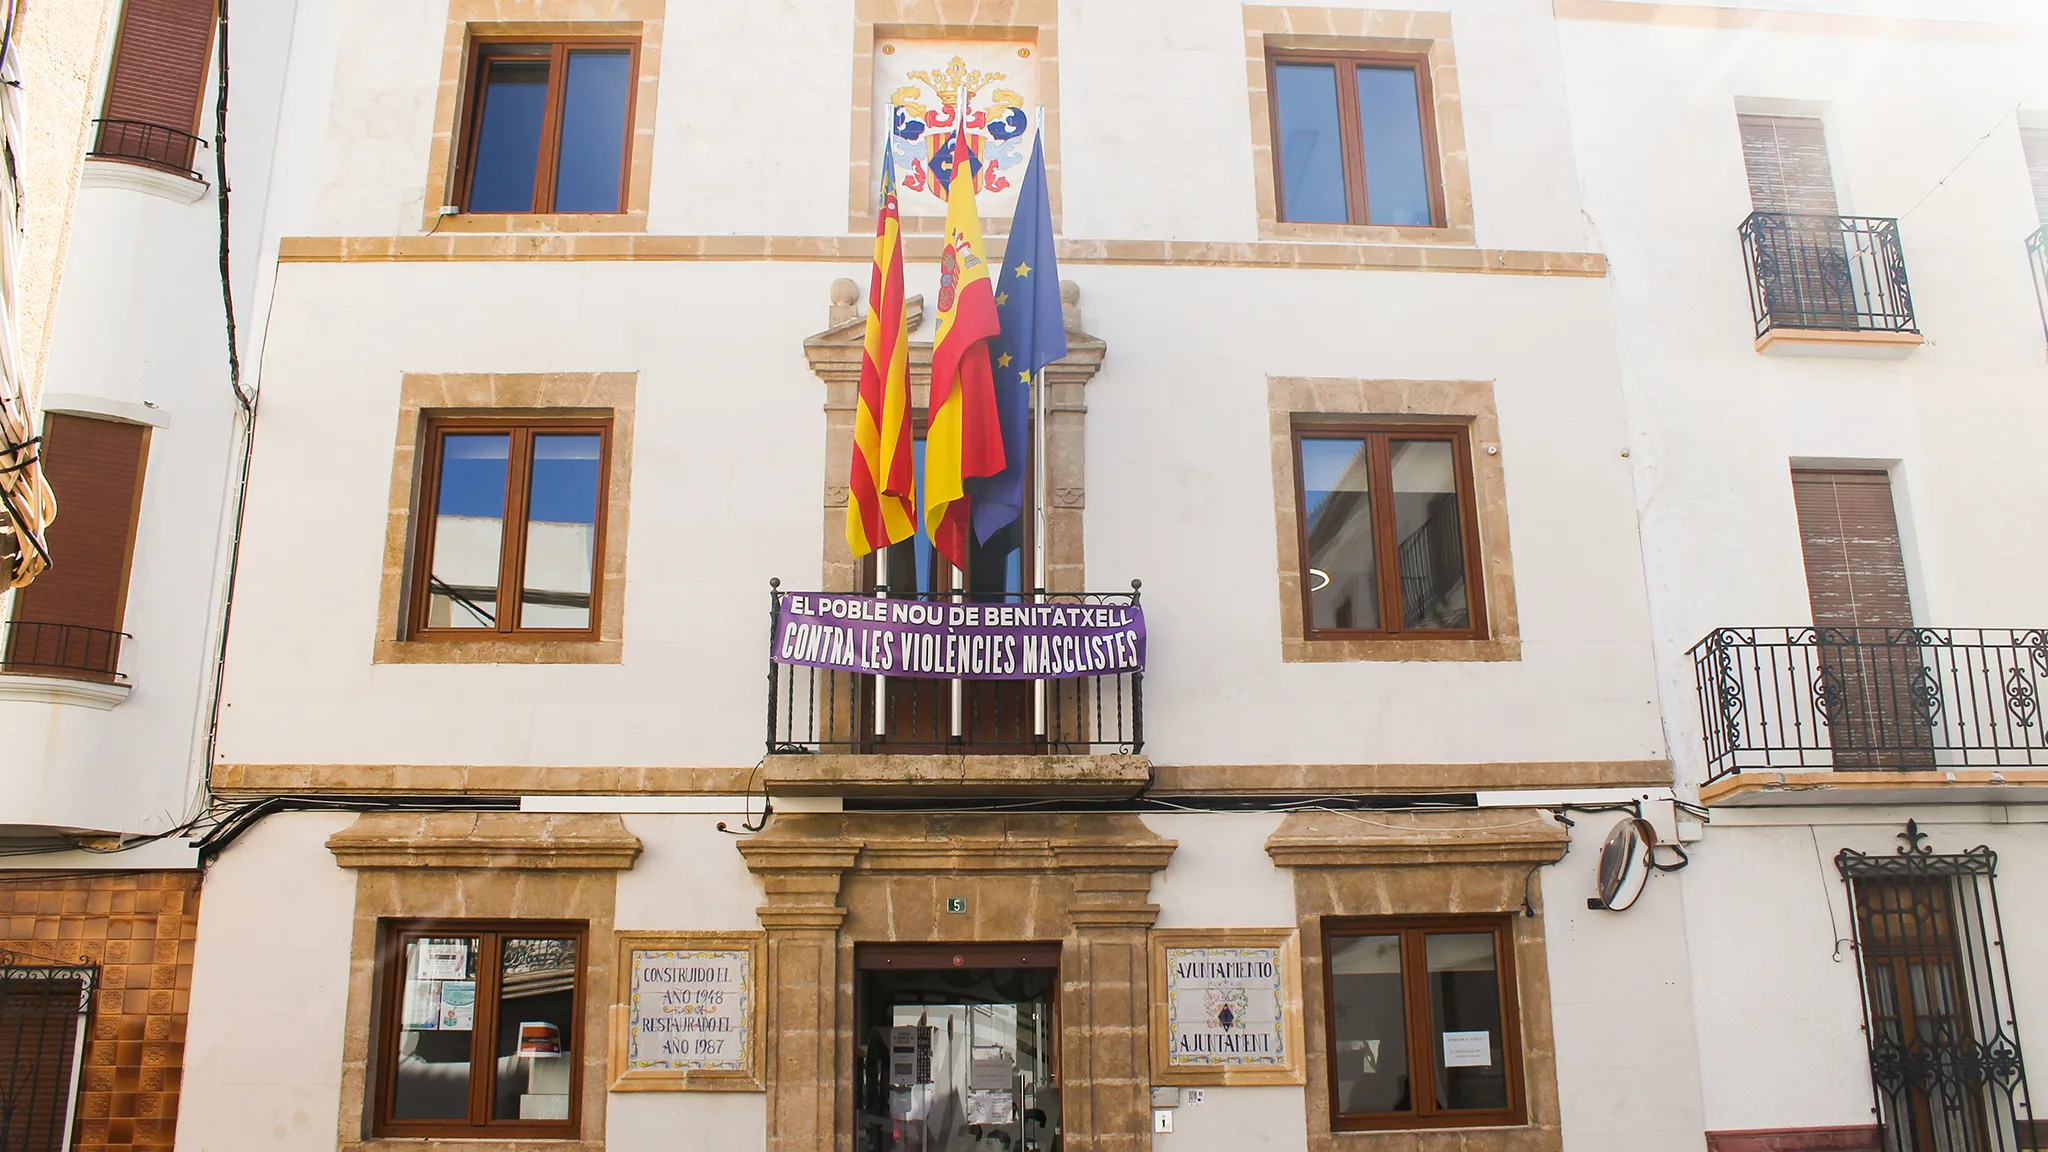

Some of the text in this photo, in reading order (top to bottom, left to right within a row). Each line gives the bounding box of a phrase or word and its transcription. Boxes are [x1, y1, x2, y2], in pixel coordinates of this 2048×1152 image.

[790, 595, 1134, 627] EL POBLE NOU DE BENITATXELL
[781, 621, 1139, 674] CONTRA LES VIOLÈNCIES MASCLISTES
[953, 899, 960, 911] 5
[643, 967, 732, 983] CONSTRUIDO EL
[1177, 962, 1272, 979] AYUNTAMIENTO
[662, 987, 724, 1005] AÑO 1948
[642, 1016, 734, 1033] RESTAURADO EL
[662, 1037, 725, 1054] AÑO 1987
[1180, 1033, 1271, 1052] AJUNTAMENT
